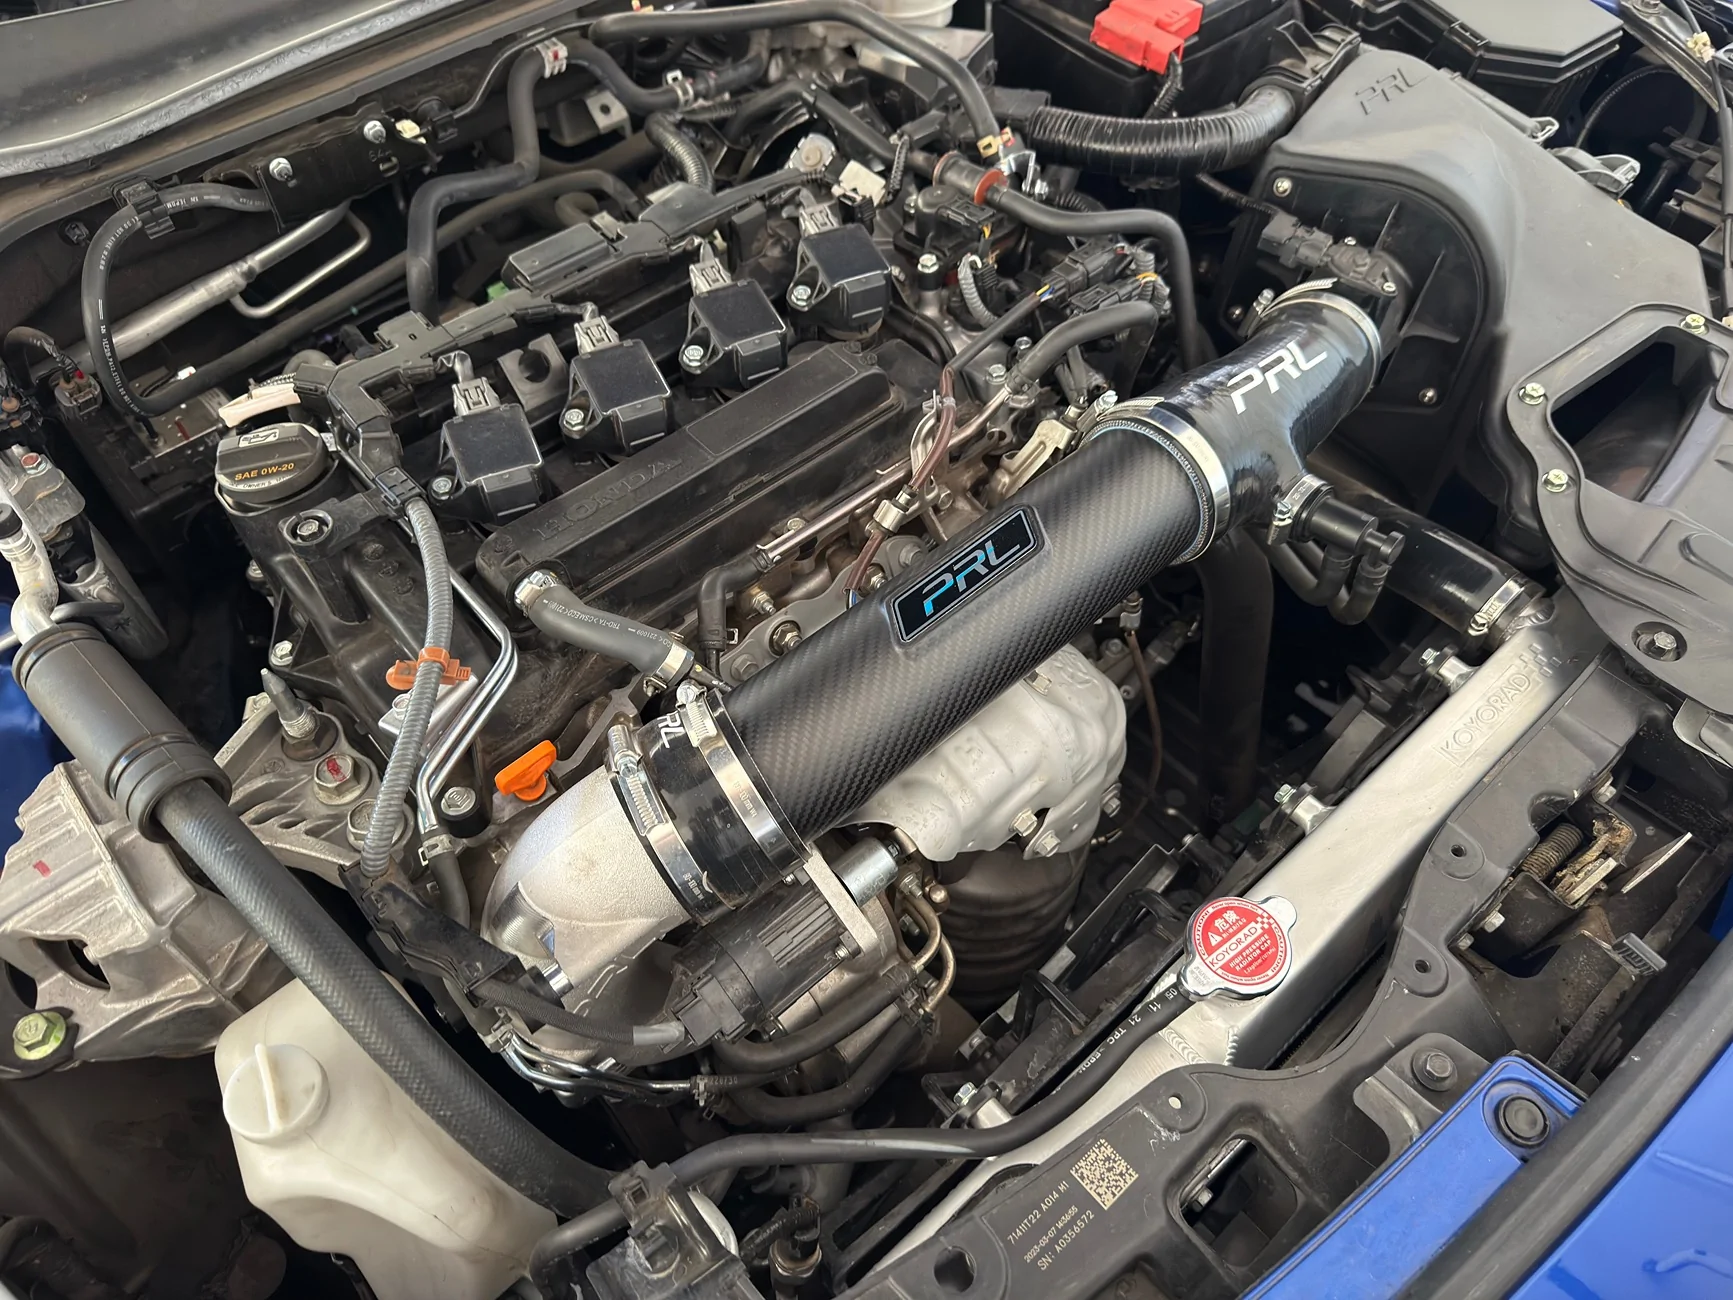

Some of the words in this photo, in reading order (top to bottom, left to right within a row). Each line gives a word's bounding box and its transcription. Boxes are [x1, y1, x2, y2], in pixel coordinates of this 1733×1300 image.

[1354, 67, 1430, 116] PRL
[1226, 338, 1329, 415] PRL
[234, 469, 259, 481] SAE
[260, 462, 295, 476] 0W-20
[922, 540, 1021, 617] PRL
[657, 710, 685, 749] RL
[1440, 672, 1531, 760] KOYORAD
[1196, 910, 1210, 957] CAUTION!
[1214, 910, 1240, 932] 危険
[1208, 926, 1258, 967] KOYORAD
[1229, 953, 1244, 968] HIGH
[1242, 933, 1270, 957] PRESSURE
[1235, 948, 1261, 972] RADIATOR
[1260, 939, 1272, 951] CAP
[1271, 926, 1284, 973] CAUTION!
[1106, 1027, 1127, 1045] TPC
[1128, 1014, 1141, 1026] 21
[1040, 1190, 1060, 1212] A014
[1023, 1226, 1057, 1264] 2023-03-07
[1037, 1251, 1056, 1271] SN:
[1054, 1209, 1095, 1254] A0356572
